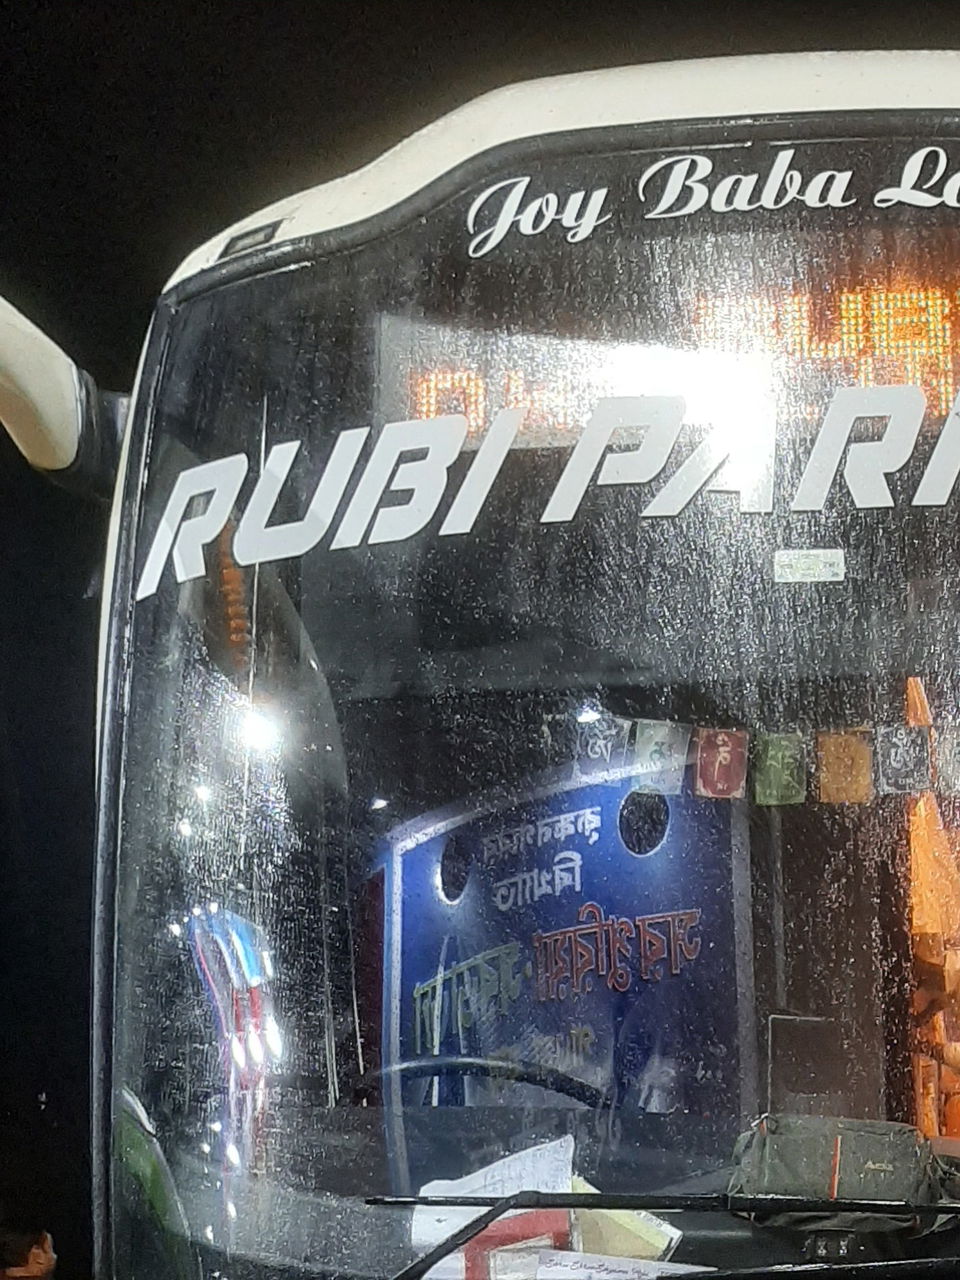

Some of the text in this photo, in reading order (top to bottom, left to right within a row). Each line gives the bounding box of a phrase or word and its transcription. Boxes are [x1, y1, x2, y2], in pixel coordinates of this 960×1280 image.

[468, 176, 611, 259] Joy
[640, 149, 857, 220] Baba
[136, 407, 526, 601] RUBI
